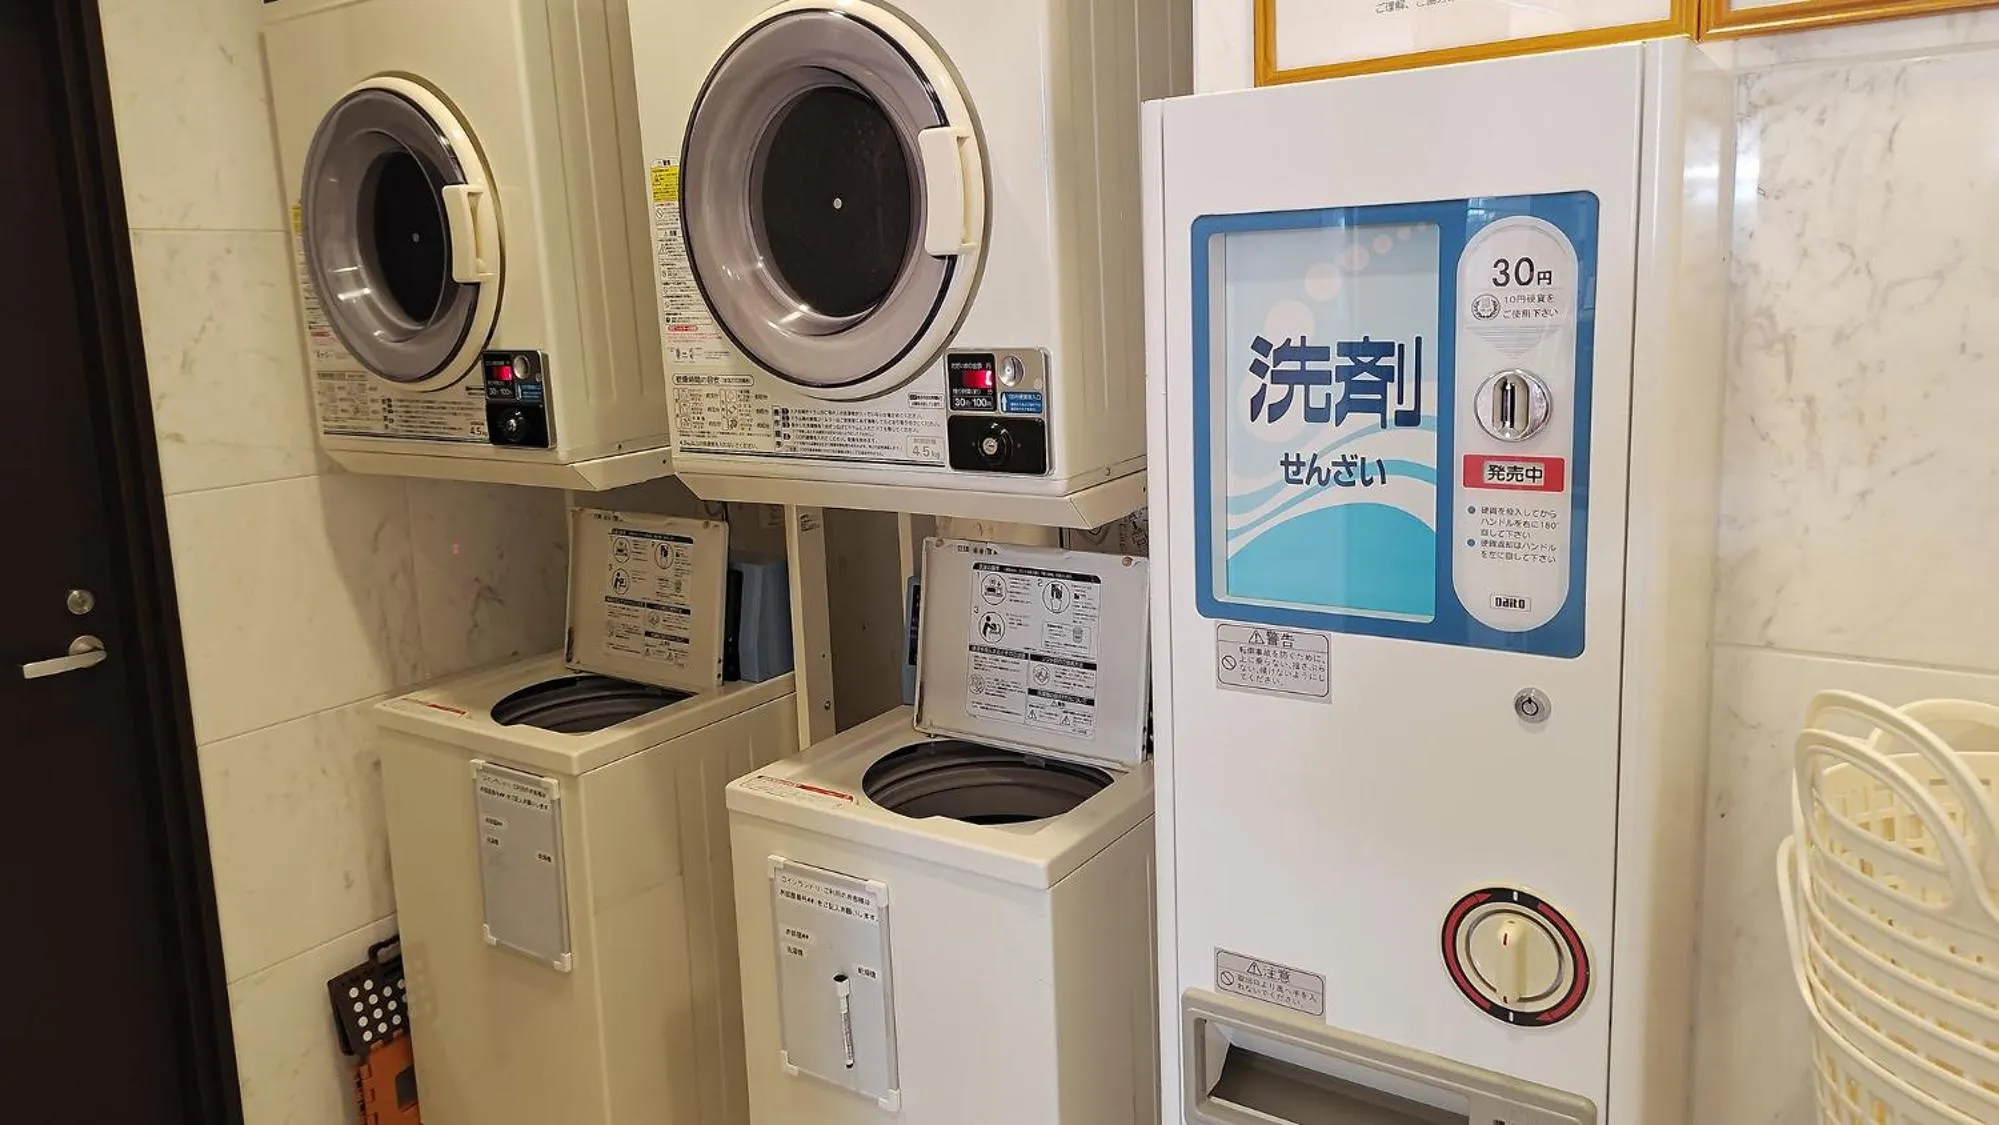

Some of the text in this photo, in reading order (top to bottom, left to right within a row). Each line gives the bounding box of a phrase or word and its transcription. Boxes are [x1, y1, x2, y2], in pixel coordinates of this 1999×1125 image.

[1492, 257, 1552, 287] 30円
[1249, 335, 1423, 429] 洗剤
[1279, 453, 1387, 488] せんざい
[1487, 464, 1543, 483] 発売中
[1266, 629, 1295, 648] 警告
[1263, 966, 1290, 984] 注意
